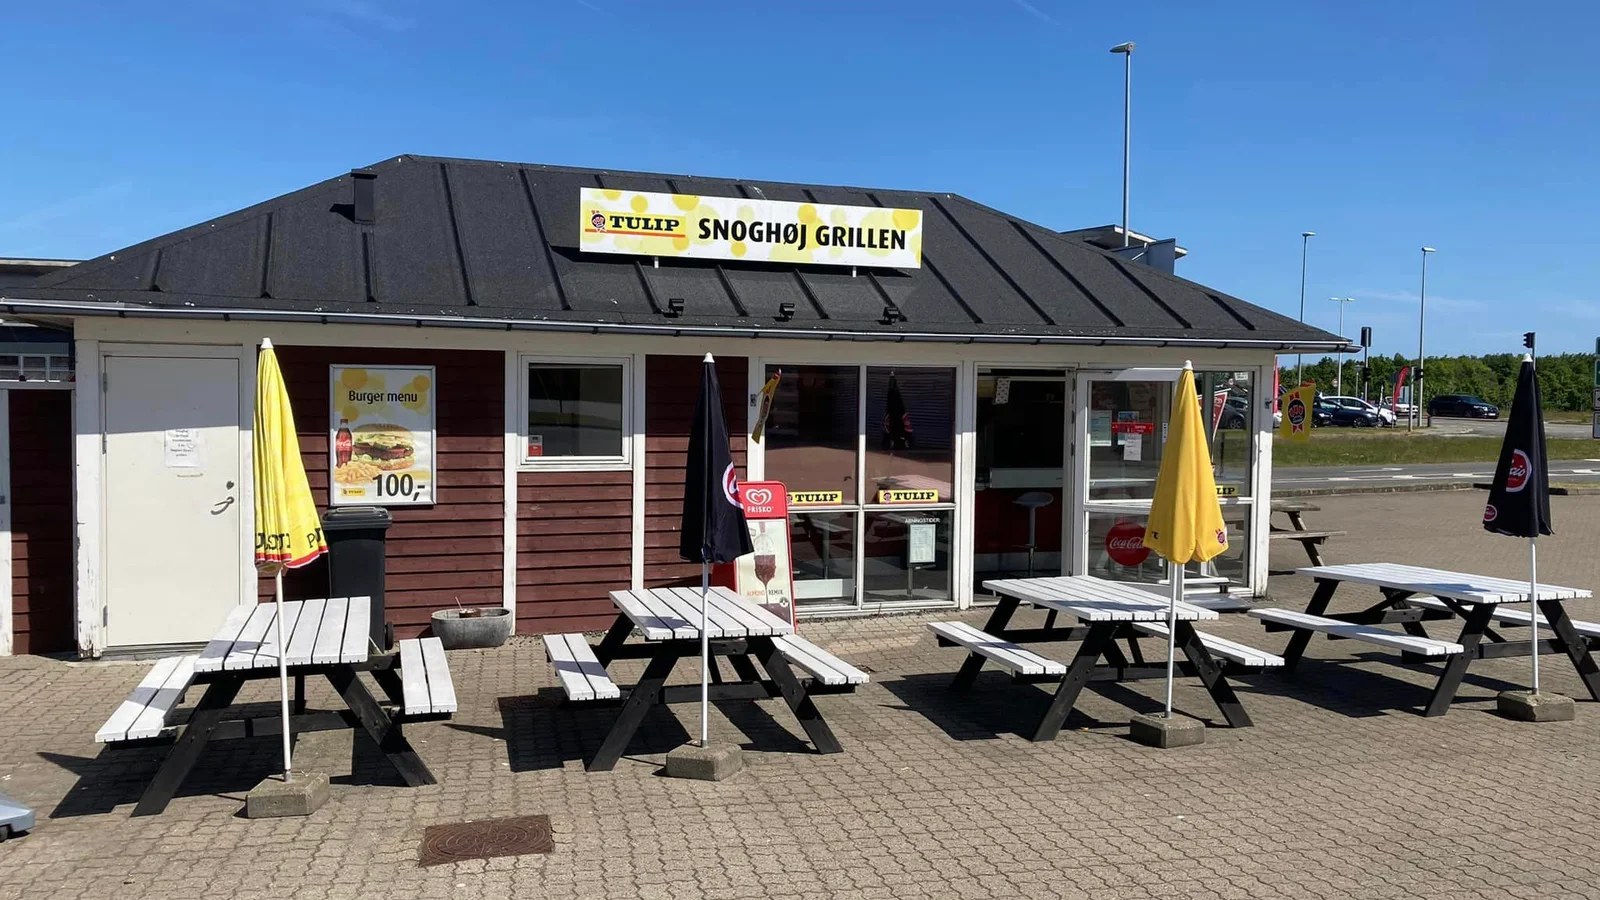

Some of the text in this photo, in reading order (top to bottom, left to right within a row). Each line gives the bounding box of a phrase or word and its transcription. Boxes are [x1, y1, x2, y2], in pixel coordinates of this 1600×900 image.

[609, 215, 680, 232] TULIP
[698, 217, 906, 251] SNOGHØJ GRILLEN
[348, 390, 418, 404] Burger menu
[372, 473, 426, 502] 100,-
[1215, 487, 1235, 495] LIP
[794, 493, 839, 503] TULIP
[894, 491, 936, 501] TULIP
